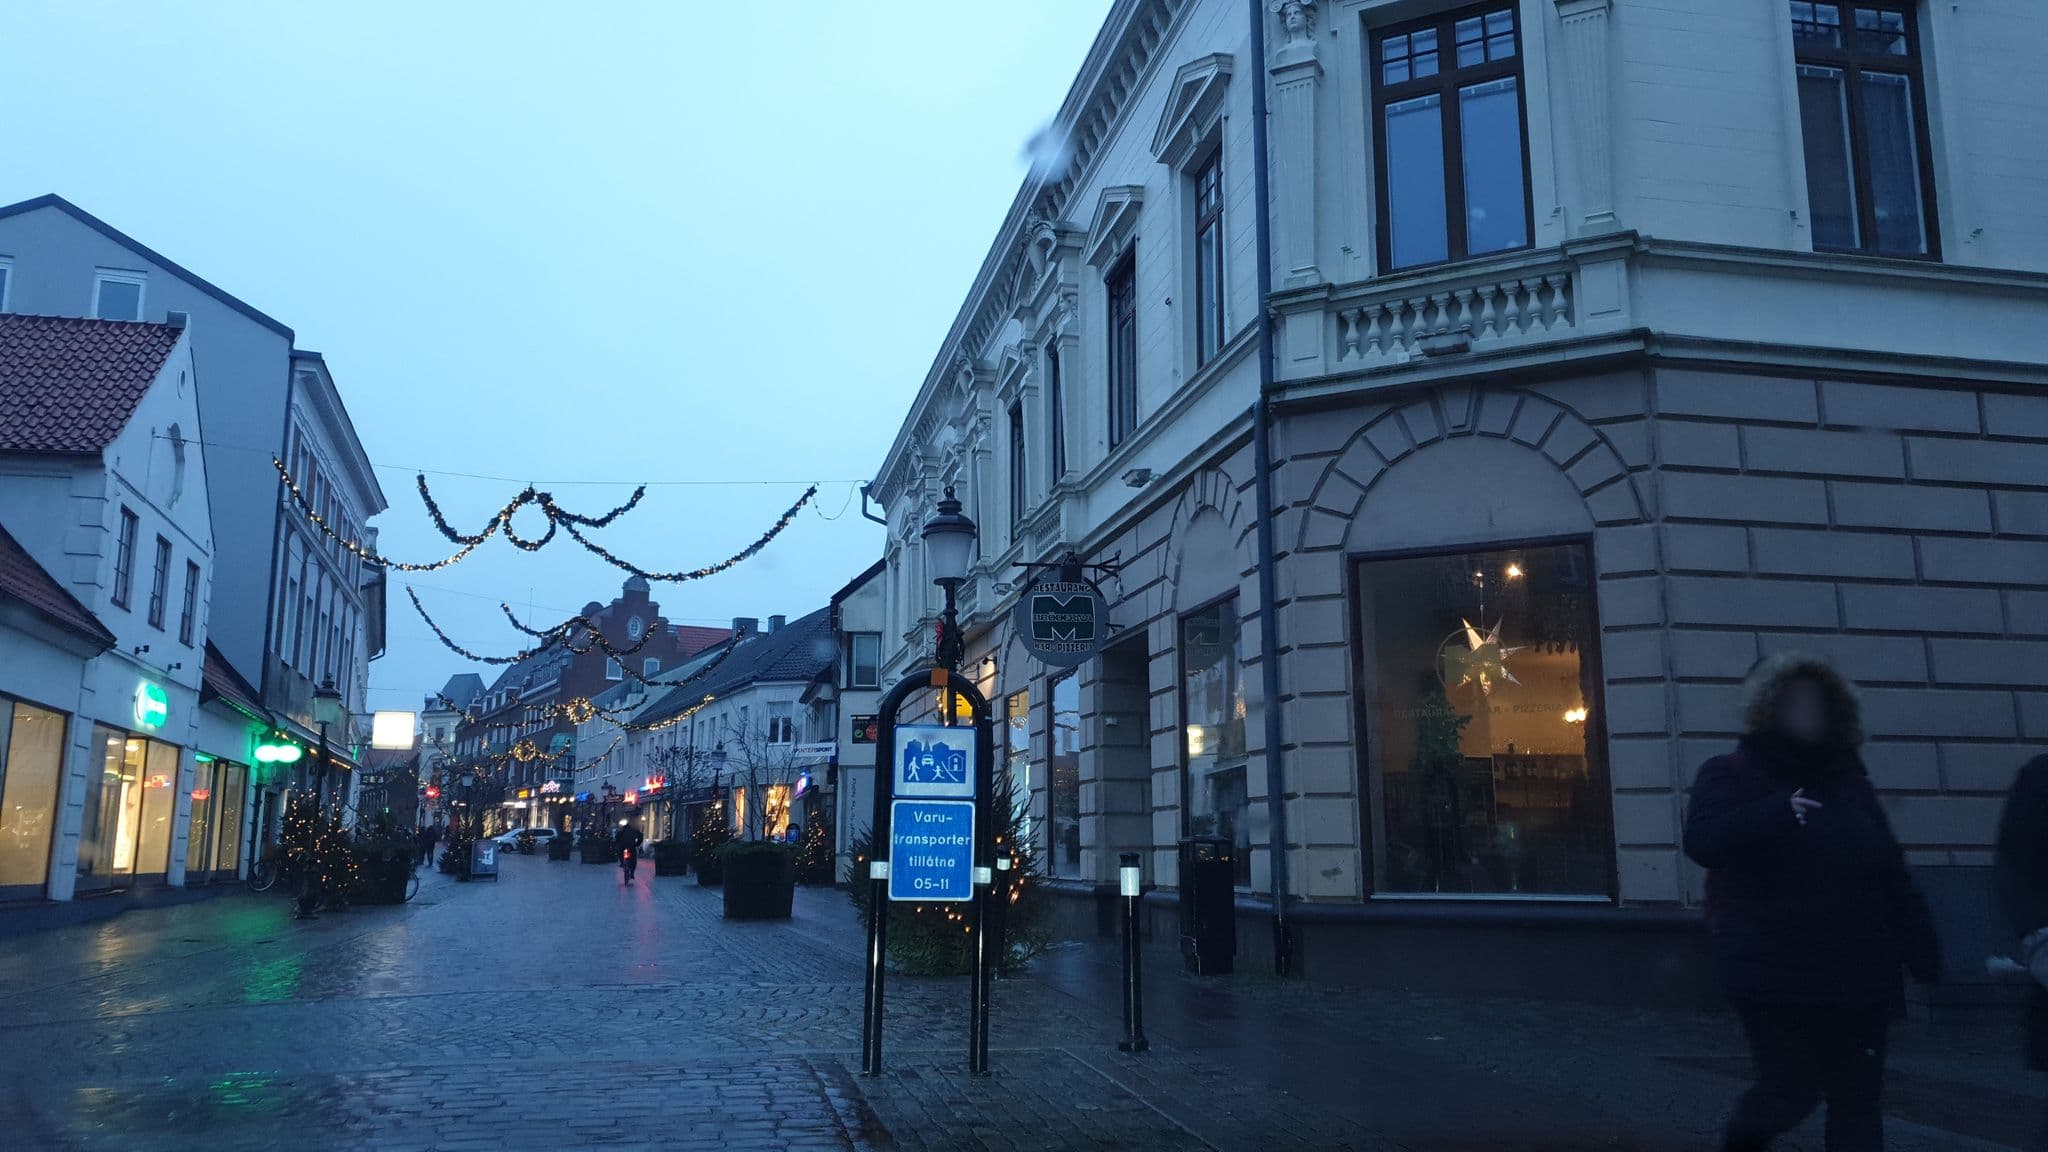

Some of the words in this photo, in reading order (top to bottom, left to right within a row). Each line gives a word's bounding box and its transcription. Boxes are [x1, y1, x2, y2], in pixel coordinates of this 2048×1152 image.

[1057, 642, 1093, 653] PIZZERIA
[913, 811, 953, 823] Varu-
[894, 832, 971, 848] transporter
[908, 855, 956, 868] tillåtna
[913, 877, 950, 890] 05-11
